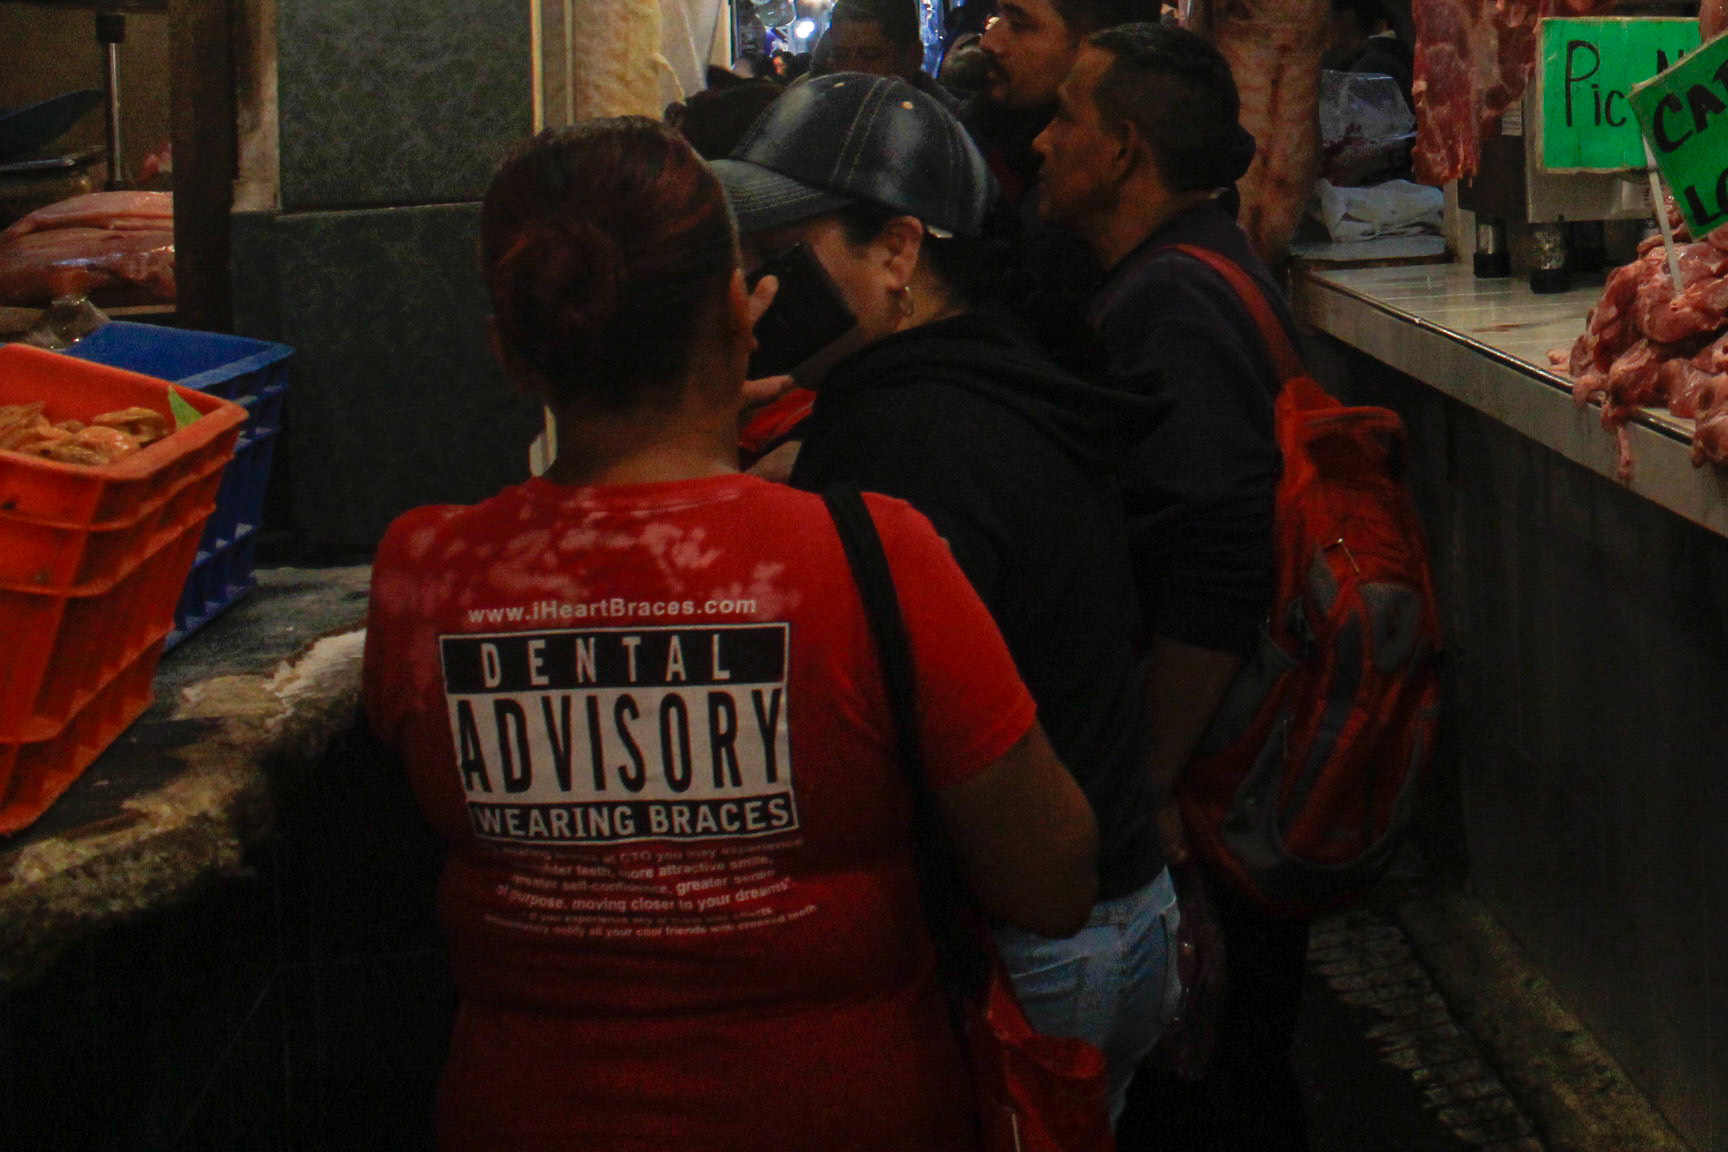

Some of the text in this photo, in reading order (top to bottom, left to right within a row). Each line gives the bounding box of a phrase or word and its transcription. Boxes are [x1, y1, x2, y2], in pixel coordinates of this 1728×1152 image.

[467, 598, 757, 623] www.iHeartBraces.com
[480, 633, 731, 689] DENTAL
[457, 688, 782, 793] ADVISORY
[476, 798, 789, 839] WEARING BRACES
[676, 876, 728, 896] greater
[571, 897, 627, 913] moving
[631, 896, 675, 911] closer
[678, 898, 693, 911] to
[696, 893, 731, 913] your
